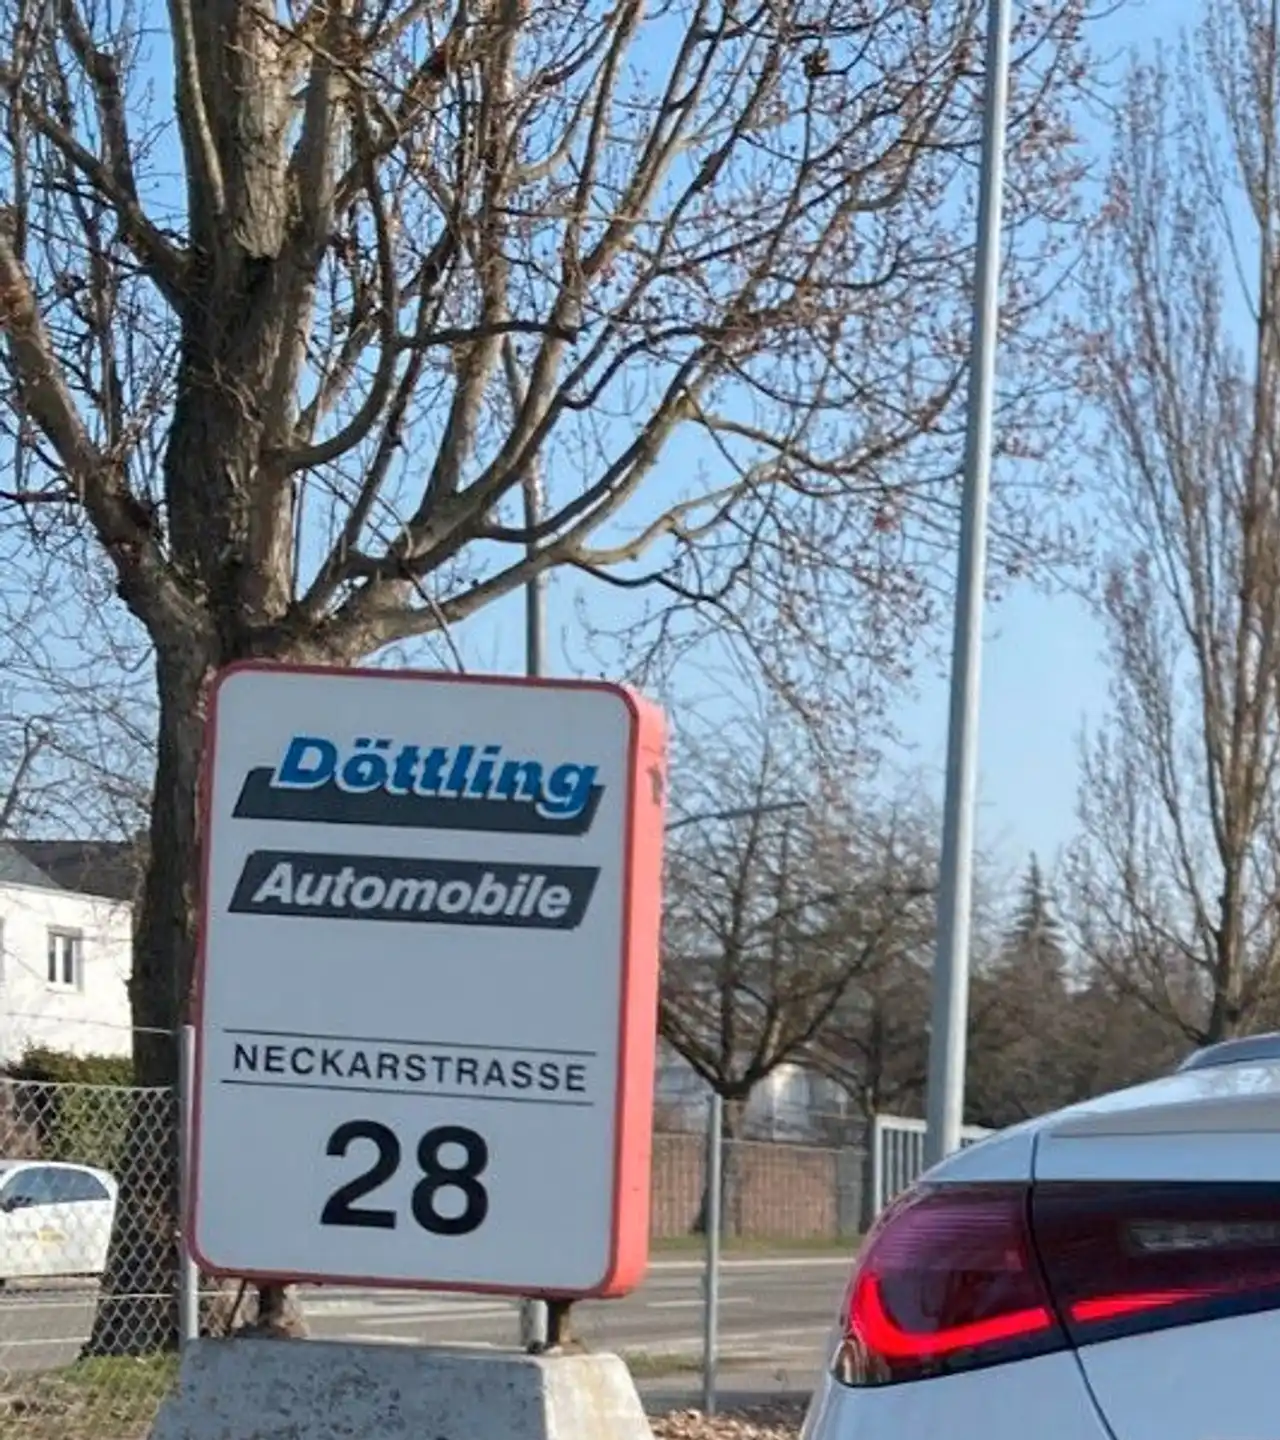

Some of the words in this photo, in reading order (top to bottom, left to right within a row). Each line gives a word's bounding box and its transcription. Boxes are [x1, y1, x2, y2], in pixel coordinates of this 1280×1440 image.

[268, 735, 600, 820] Döttling
[250, 861, 573, 921] Automobile
[233, 1042, 588, 1093] NECKARSTRASSE
[318, 1119, 490, 1237] 28
